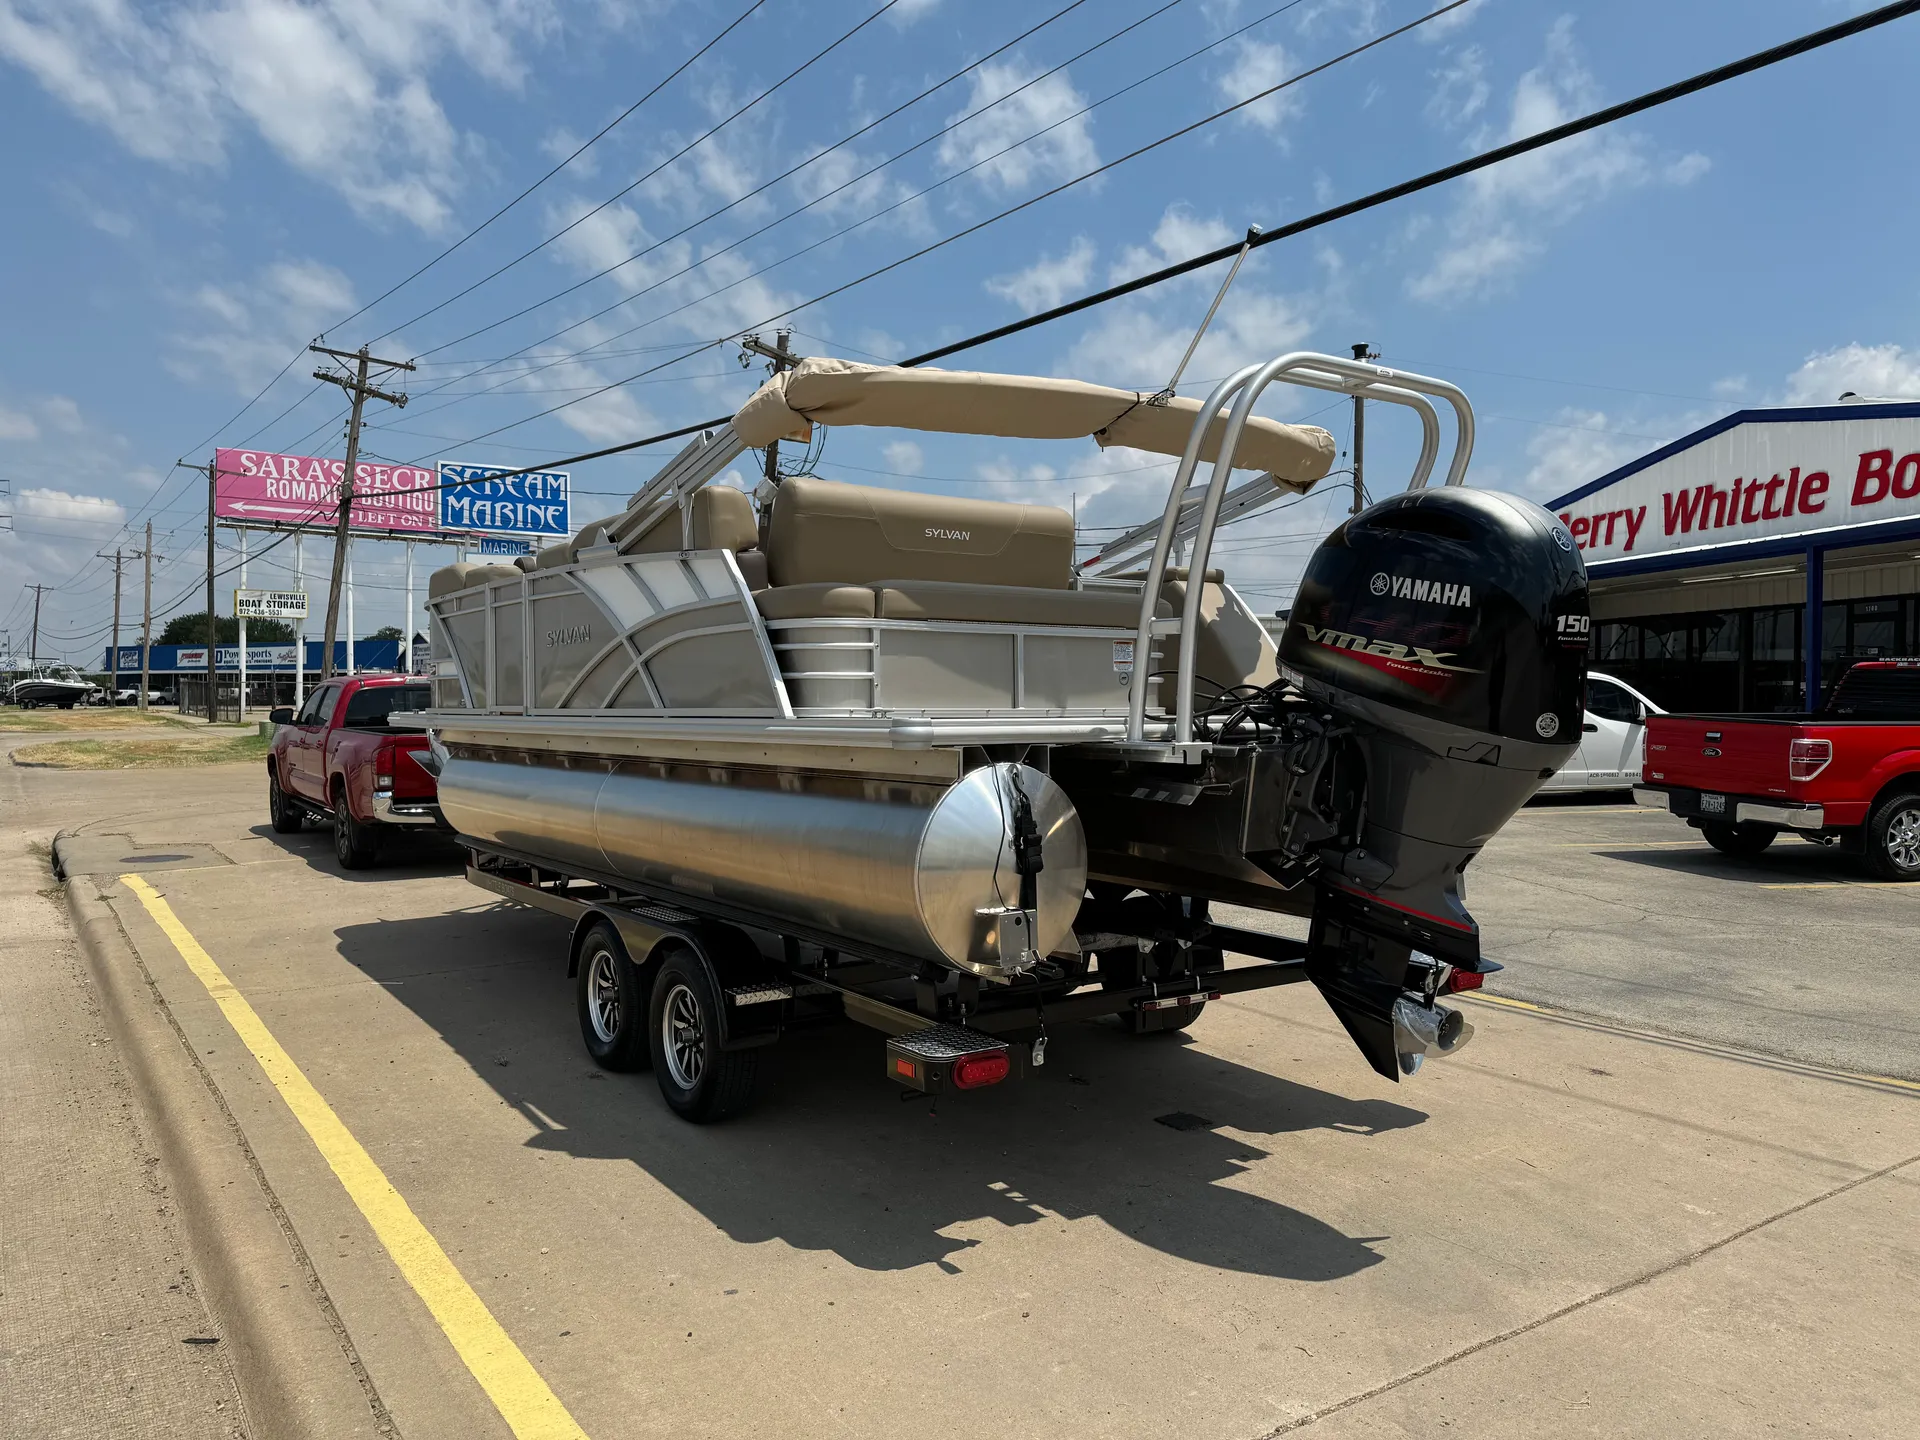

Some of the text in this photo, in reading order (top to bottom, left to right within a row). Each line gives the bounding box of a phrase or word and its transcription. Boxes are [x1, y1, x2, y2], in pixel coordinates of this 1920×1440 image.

[266, 478, 343, 504] ROMANC
[441, 465, 567, 501] SCREAM
[1662, 466, 1830, 537] Whittle
[1851, 448, 1920, 507] Bo
[358, 510, 397, 525] LEFT
[401, 514, 422, 527] ON
[445, 494, 565, 532] MARINE
[924, 528, 971, 541] SYLVAN
[1391, 575, 1471, 607] YAMAHA
[238, 599, 306, 609] BOAT STORAGE
[238, 608, 283, 616] 972-436-5531
[1557, 615, 1590, 632] 150
[546, 624, 591, 648] SYLVAN
[223, 649, 272, 660] Powsports
